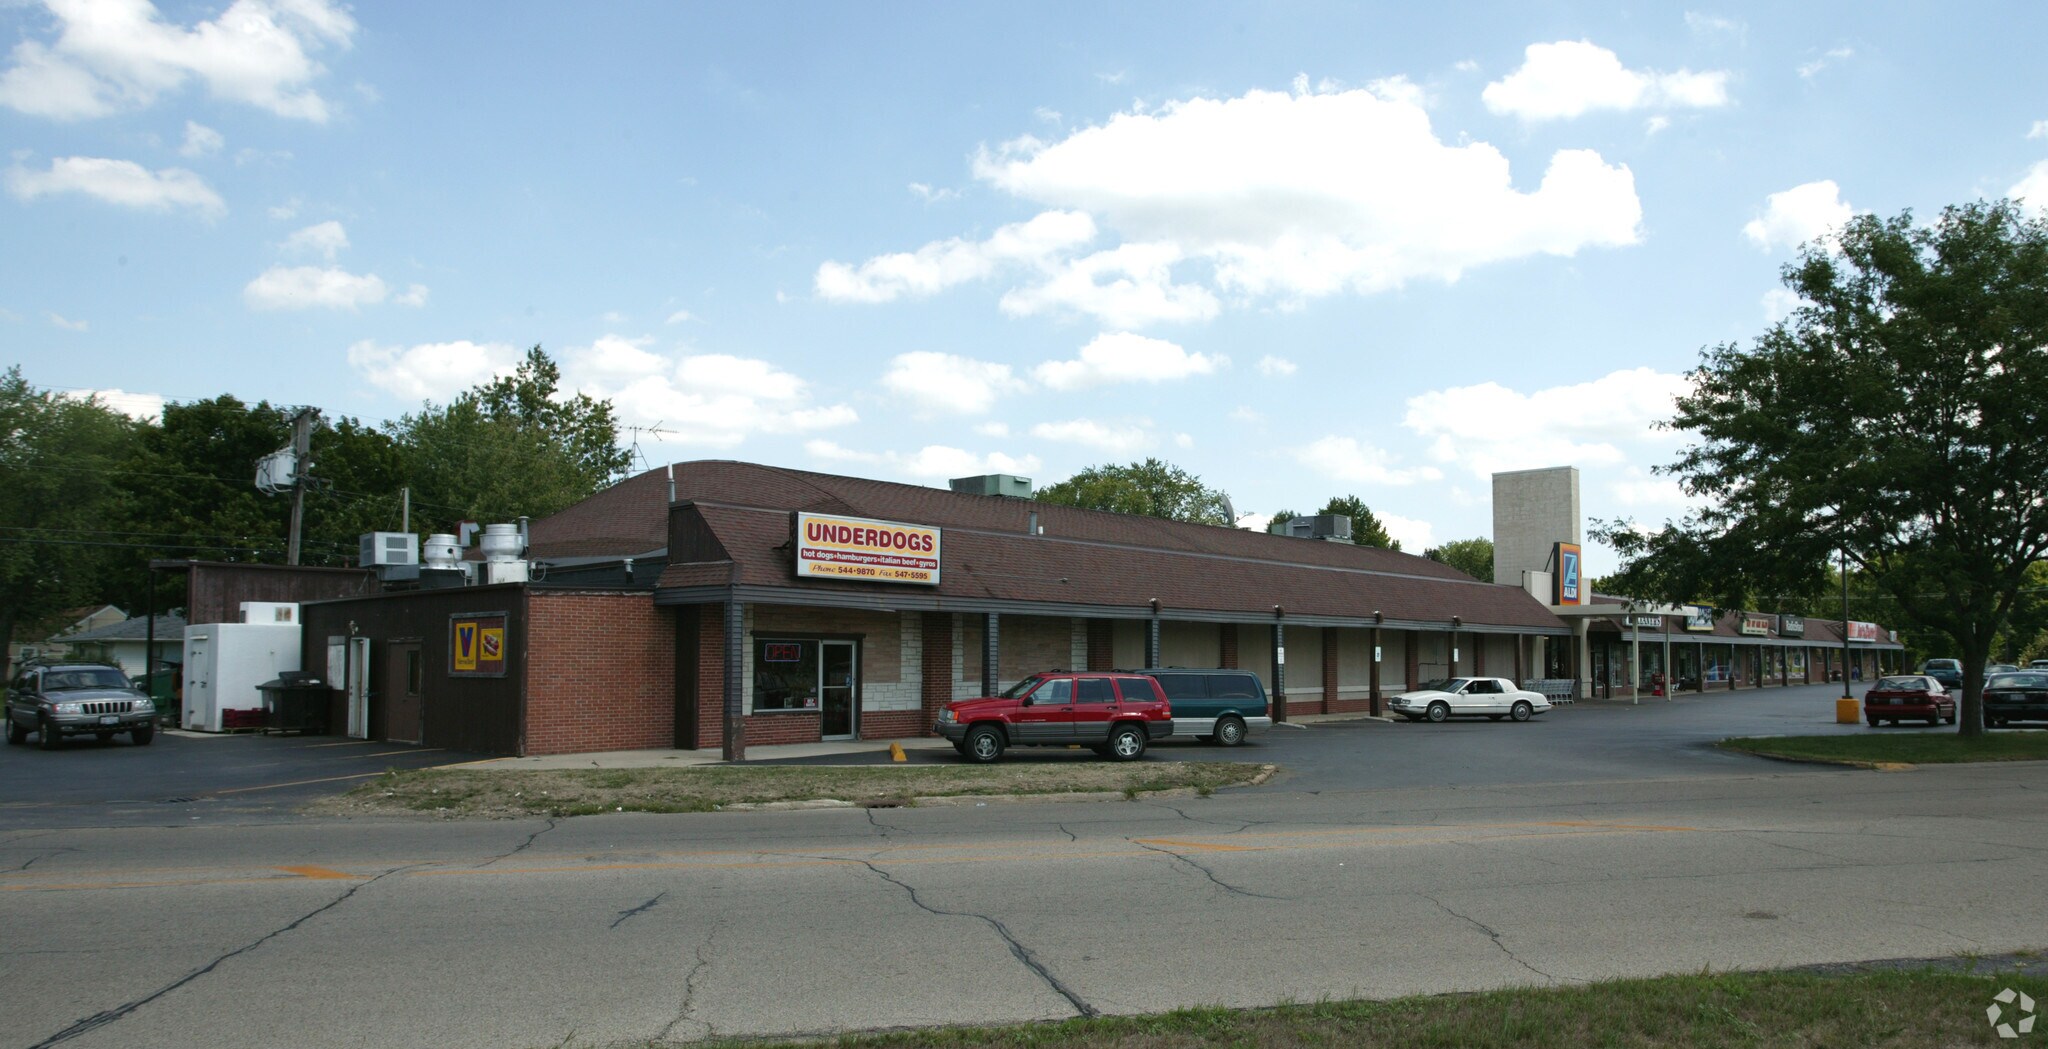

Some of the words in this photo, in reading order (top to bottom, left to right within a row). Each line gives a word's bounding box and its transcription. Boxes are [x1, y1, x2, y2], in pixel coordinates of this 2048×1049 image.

[807, 522, 933, 552] UNDERDOGS
[803, 550, 815, 558] hot
[816, 551, 834, 560] dogs
[836, 552, 877, 563] hamburgers
[879, 555, 901, 564] italian
[901, 557, 917, 565] beef
[918, 559, 936, 568] gyros
[812, 565, 835, 573] Phone
[879, 569, 893, 577] Fax
[1564, 586, 1577, 599] ALDI
[767, 644, 799, 660] OPEN
